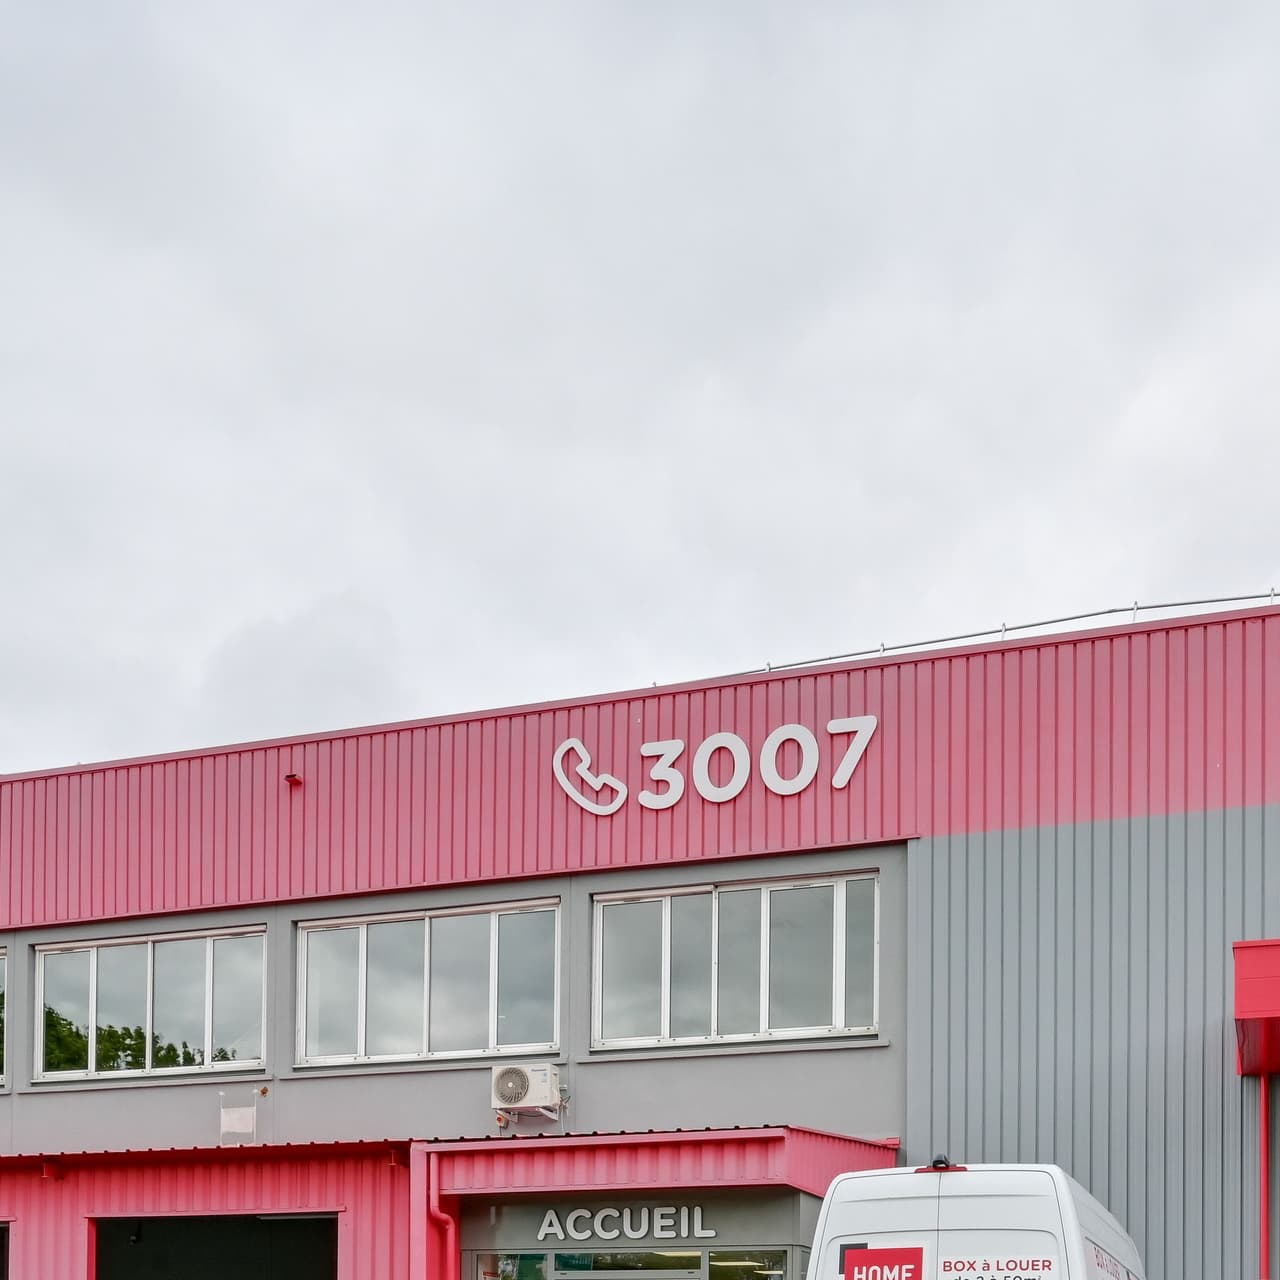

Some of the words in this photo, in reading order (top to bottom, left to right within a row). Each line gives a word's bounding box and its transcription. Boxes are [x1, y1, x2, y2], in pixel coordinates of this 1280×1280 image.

[637, 715, 878, 810] 3007
[536, 1206, 718, 1241] ACCUEIL
[943, 1260, 977, 1272] BOX
[982, 1259, 991, 1271] à
[996, 1259, 1053, 1271] LOUER
